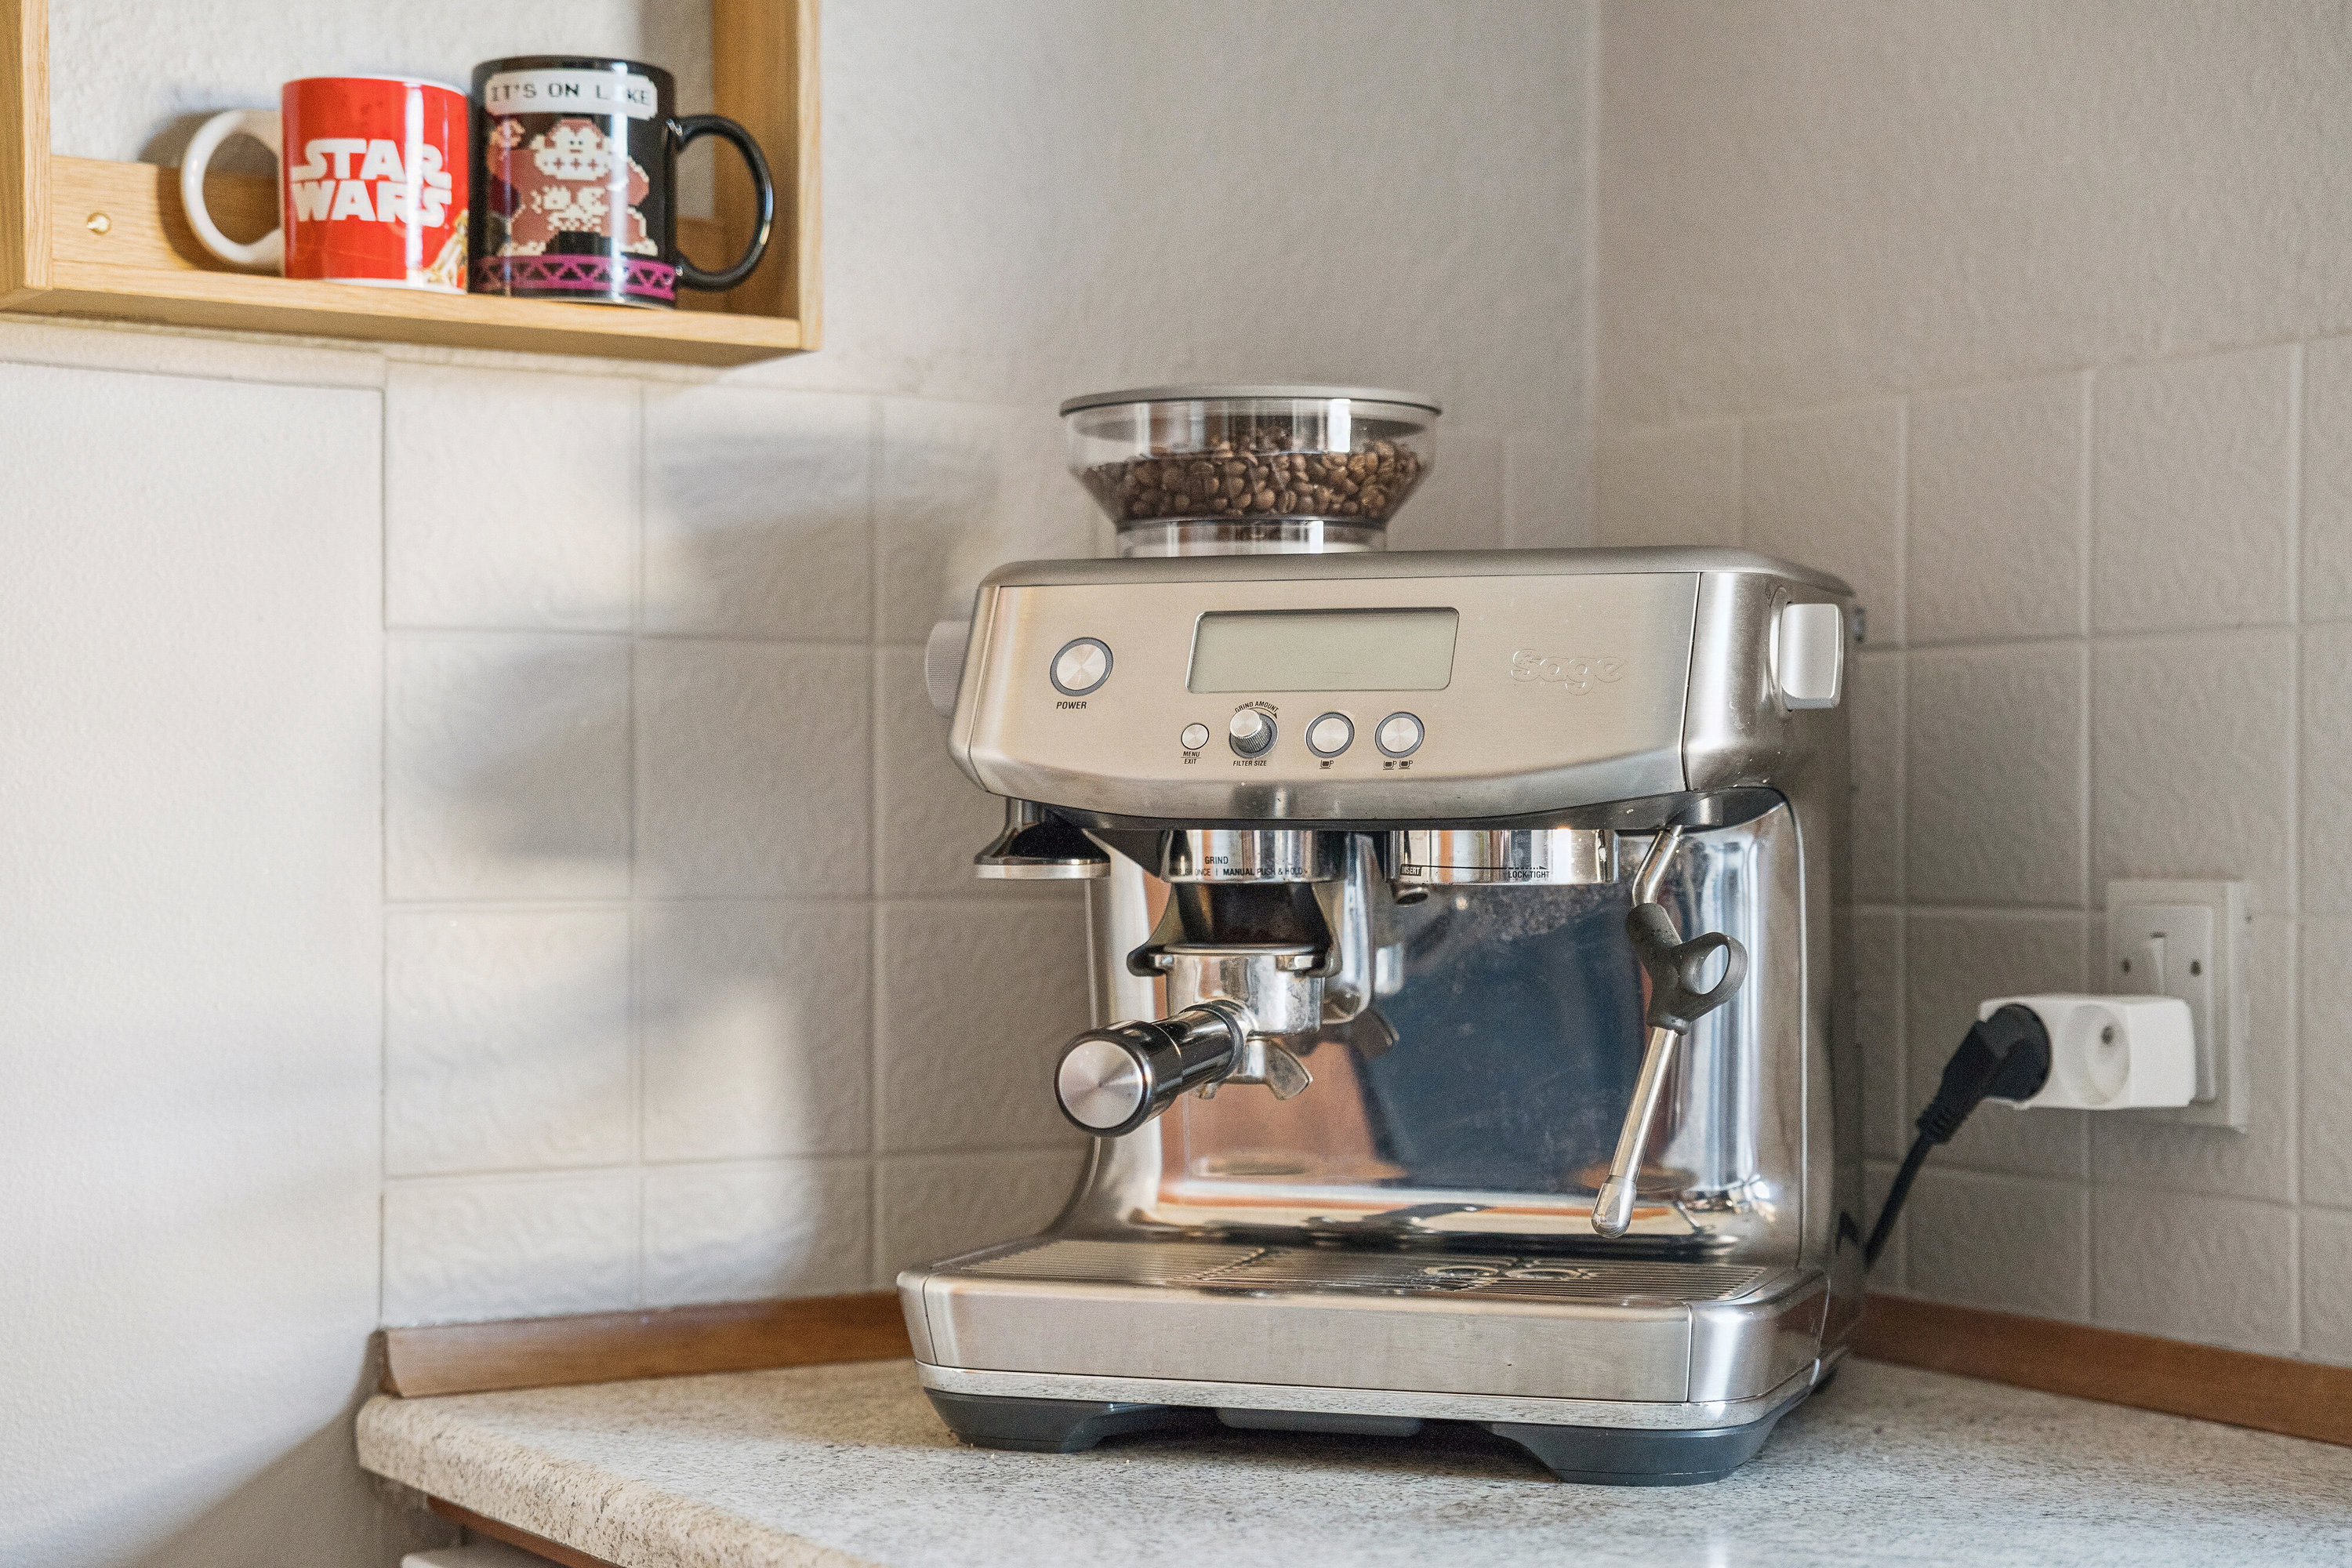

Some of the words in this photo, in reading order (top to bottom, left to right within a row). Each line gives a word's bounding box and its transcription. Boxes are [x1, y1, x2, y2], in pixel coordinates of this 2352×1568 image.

[491, 82, 537, 102] IT'S
[548, 82, 579, 98] ON
[596, 84, 651, 107] LKE
[291, 138, 452, 190] STAR
[291, 179, 452, 227] WARS
[1510, 648, 1628, 696] Sage
[1056, 701, 1087, 710] POWER
[1234, 701, 1254, 713] GRIND
[1254, 700, 1279, 713] AMOUNT
[1204, 856, 1229, 865] GRIND
[1223, 868, 1254, 877] MANUAL
[1284, 867, 1303, 876] HOLD
[1508, 870, 1528, 879] LOCK
[1529, 870, 1550, 879] TIGHT
